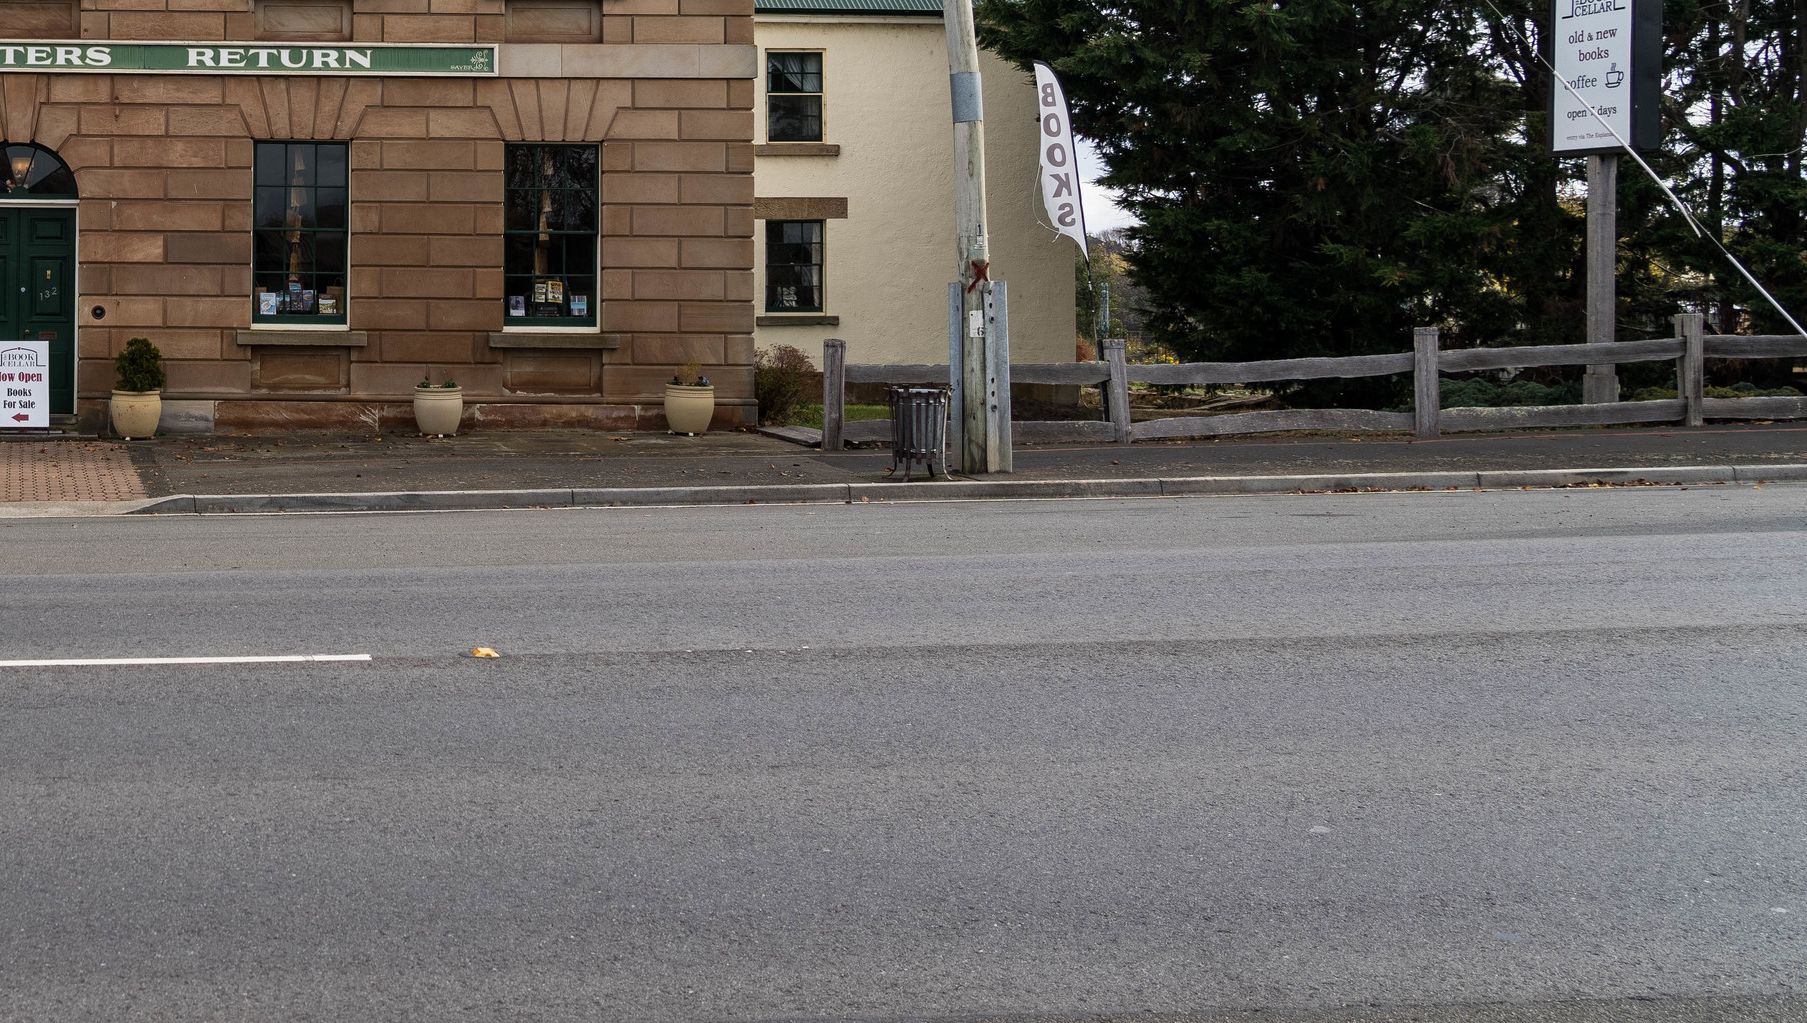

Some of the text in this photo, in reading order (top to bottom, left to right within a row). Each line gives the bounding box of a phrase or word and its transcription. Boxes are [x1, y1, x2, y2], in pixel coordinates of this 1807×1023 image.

[1575, 1, 1613, 17] CELLAR
[1569, 28, 1618, 44] old & new
[187, 47, 373, 69] RETURN
[1578, 46, 1610, 62] books
[1567, 109, 1587, 121] open
[1597, 105, 1617, 117] days
[40, 287, 57, 301] 132
[8, 353, 34, 361] BOOK
[18, 371, 42, 383] Open
[7, 388, 32, 397] Books
[3, 400, 36, 410] For Sale
